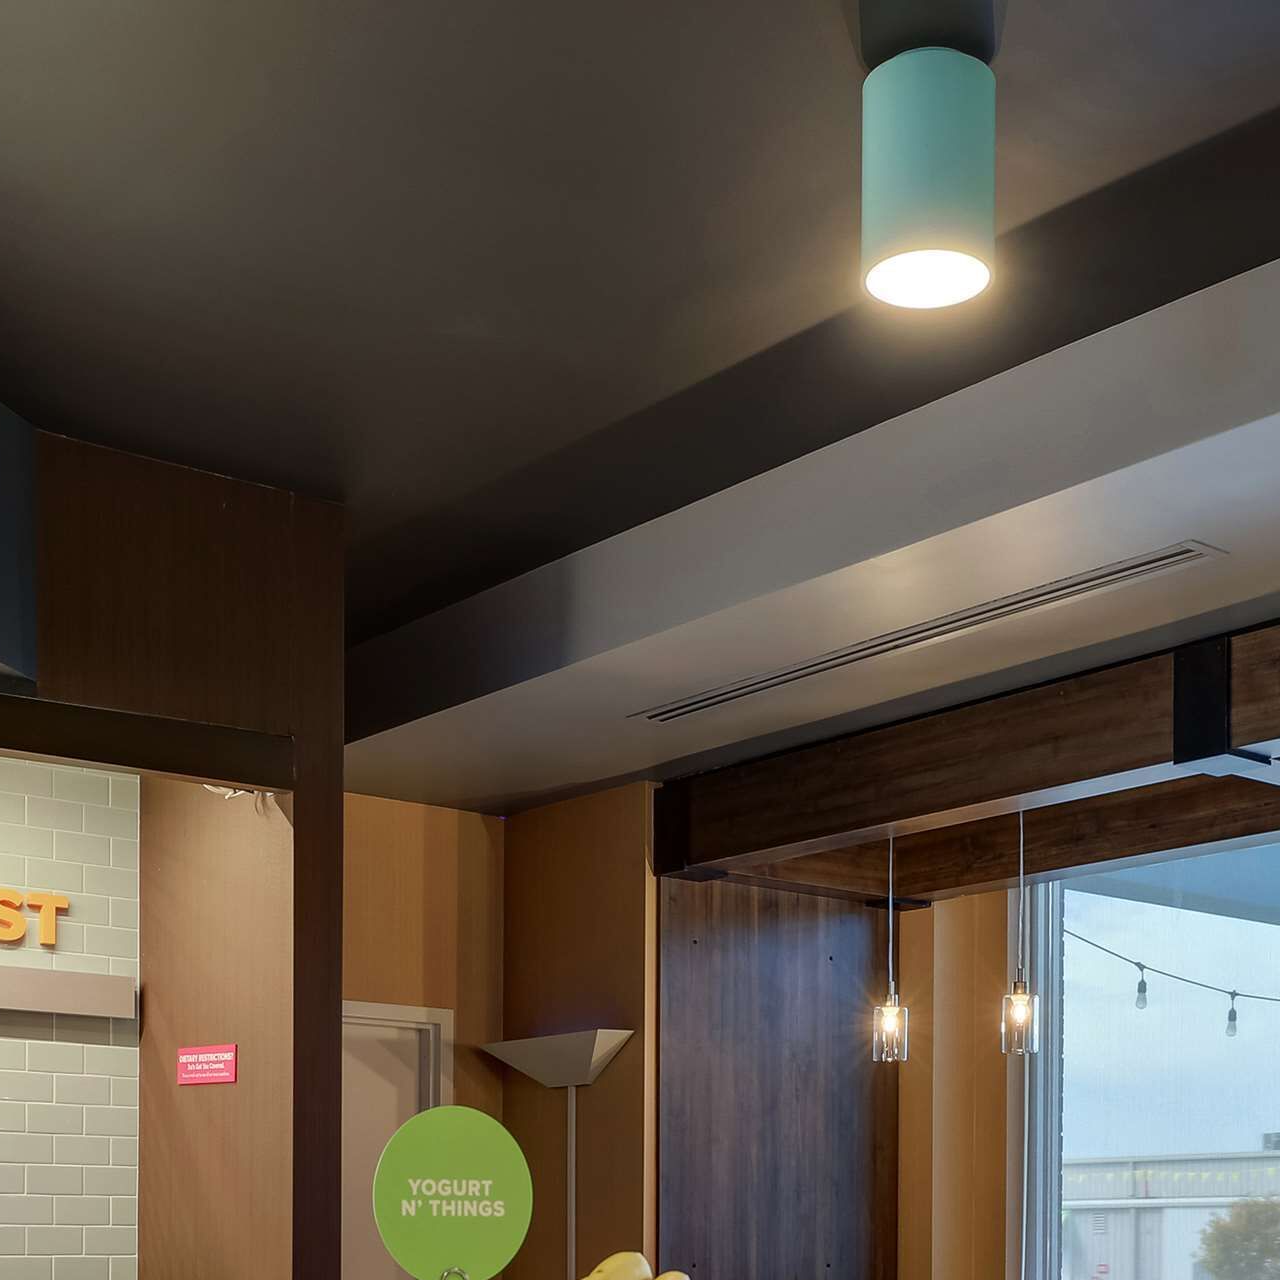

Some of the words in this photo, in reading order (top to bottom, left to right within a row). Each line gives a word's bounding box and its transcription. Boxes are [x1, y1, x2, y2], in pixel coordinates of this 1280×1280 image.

[408, 1179, 493, 1196] YOGURT
[401, 1200, 423, 1217] N'
[429, 1200, 505, 1217] THINGS
